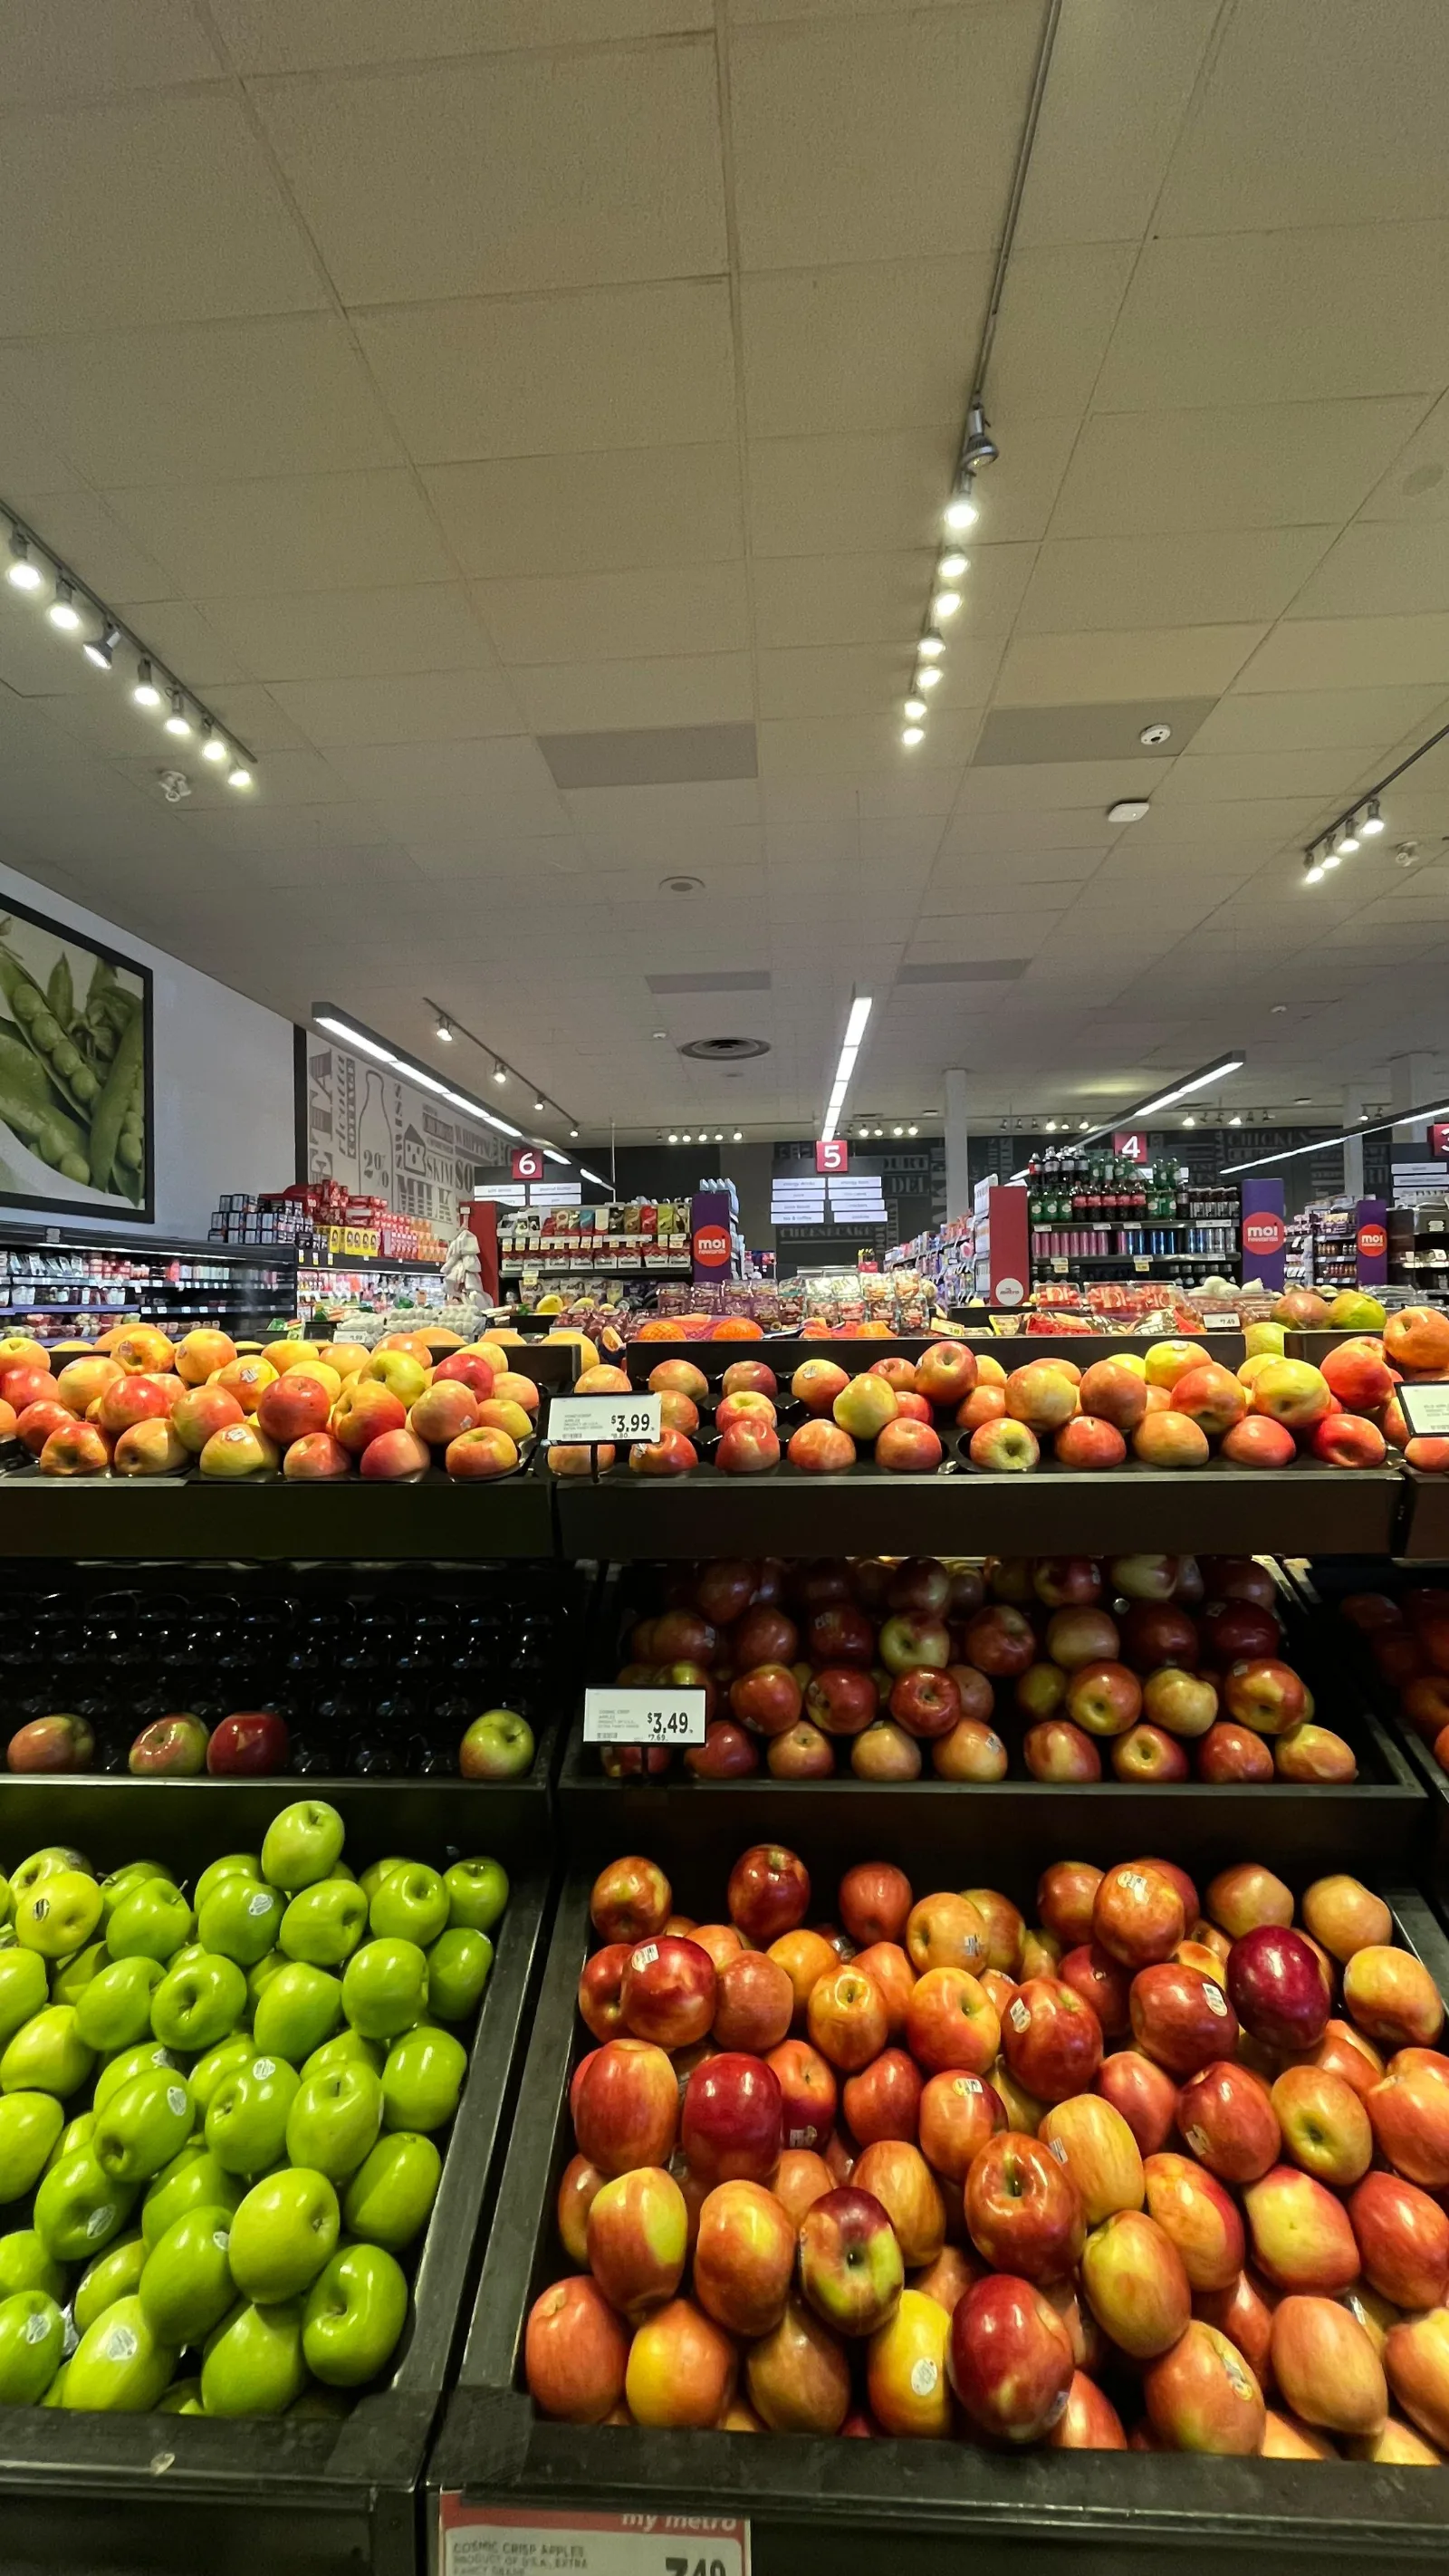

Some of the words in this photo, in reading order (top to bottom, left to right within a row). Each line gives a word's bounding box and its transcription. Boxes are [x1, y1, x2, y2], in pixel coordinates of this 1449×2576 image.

[309, 1048, 333, 1183] ETA
[824, 1145, 841, 1168] 5
[1121, 1135, 1141, 1158] 4
[427, 1156, 454, 1187] SKIM
[518, 1152, 536, 1176] 6
[455, 1159, 474, 1193] SO
[396, 1174, 454, 1222] MILK
[1247, 1223, 1278, 1236] moi
[1361, 1232, 1384, 1244] moi
[698, 1235, 726, 1250] moi
[610, 1413, 650, 1433] $3.99
[647, 1712, 688, 1734] $3.49
[622, 2514, 657, 2533] my
[454, 2541, 498, 2554] COSMIC
[503, 2542, 536, 2555] CRISP
